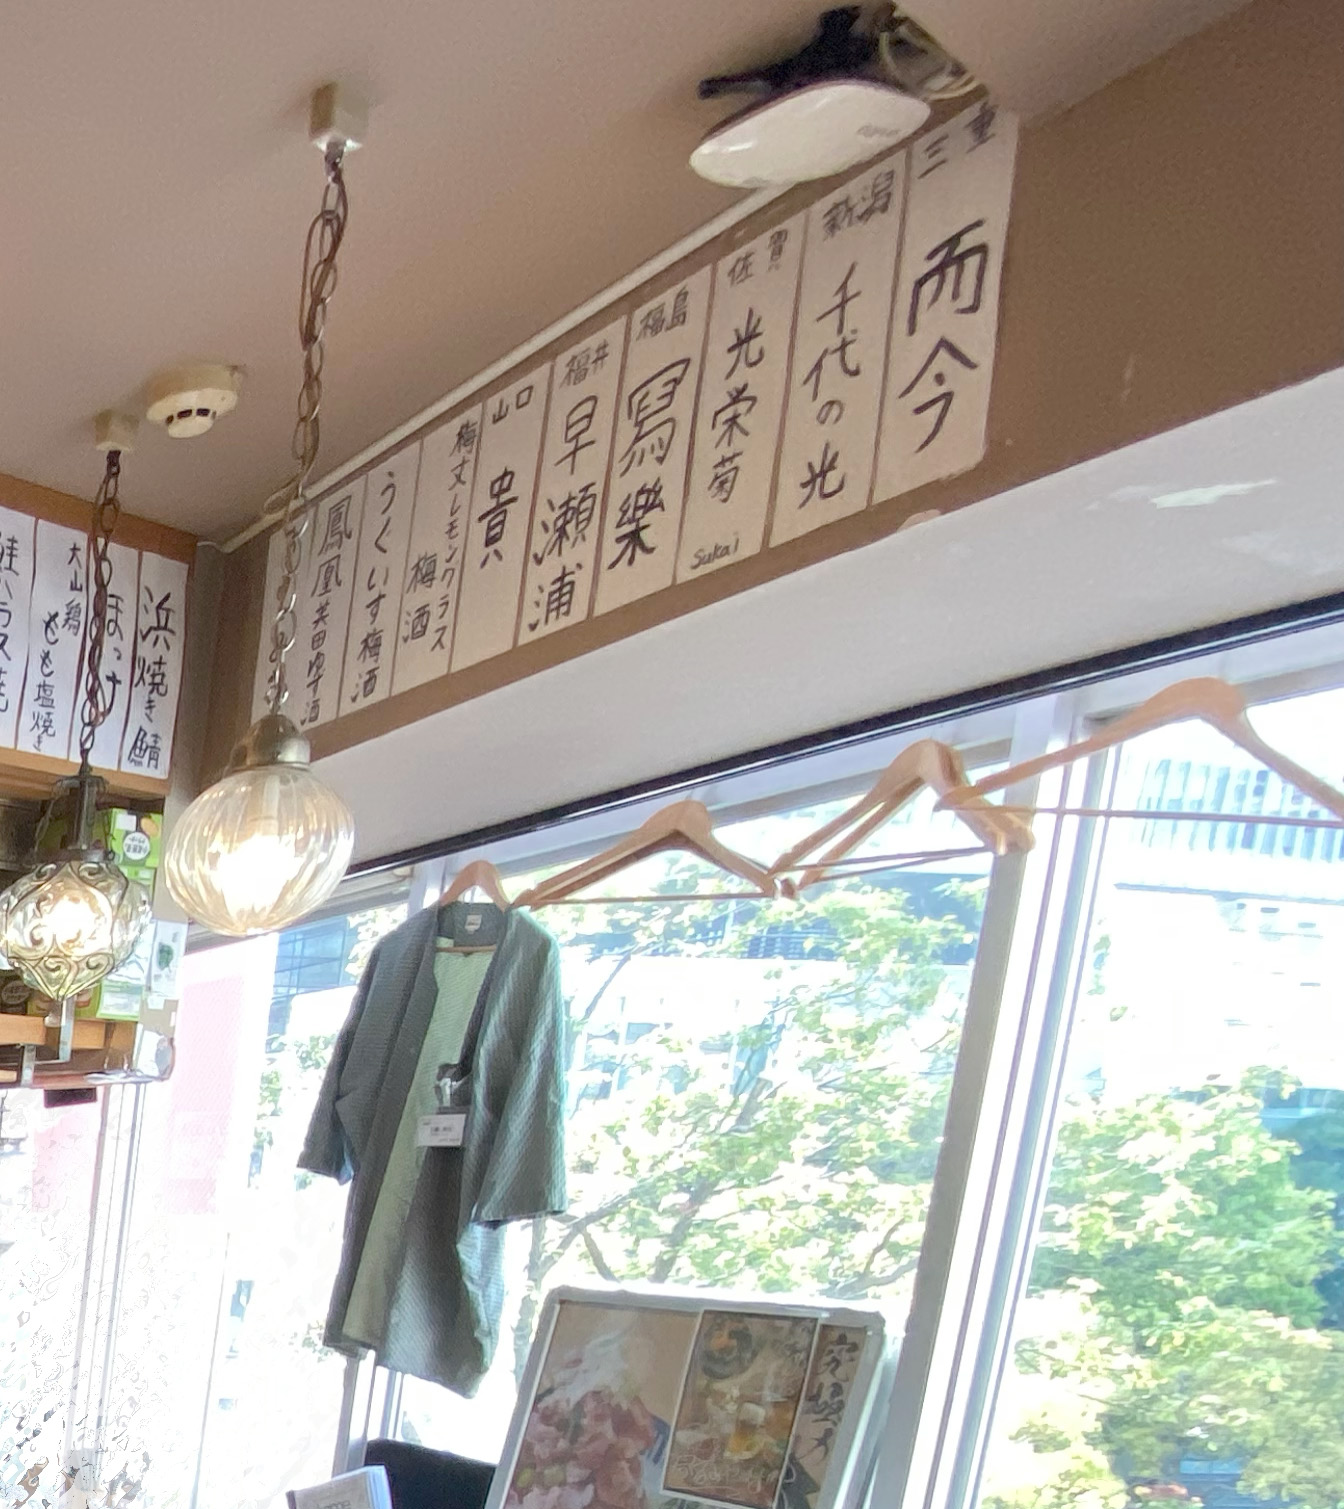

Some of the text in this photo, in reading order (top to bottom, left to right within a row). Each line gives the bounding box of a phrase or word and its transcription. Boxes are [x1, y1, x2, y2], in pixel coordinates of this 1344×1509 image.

[918, 102, 999, 180] 三重
[821, 172, 895, 240] 新潟
[726, 231, 788, 288] 佐賀
[635, 290, 688, 341] 福島
[899, 220, 990, 453] 而今
[490, 386, 534, 424] 山口
[560, 344, 608, 388] 福井
[707, 307, 767, 503] 光栄菊
[798, 262, 861, 510] 千代の光
[478, 467, 520, 570] 貴
[528, 395, 599, 632] 早瀬浦
[64, 542, 83, 637] 大山鶏
[402, 555, 437, 645] 梅酒
[30, 610, 60, 752] もも塩焼き
[129, 585, 177, 770] 浜焼き鯖
